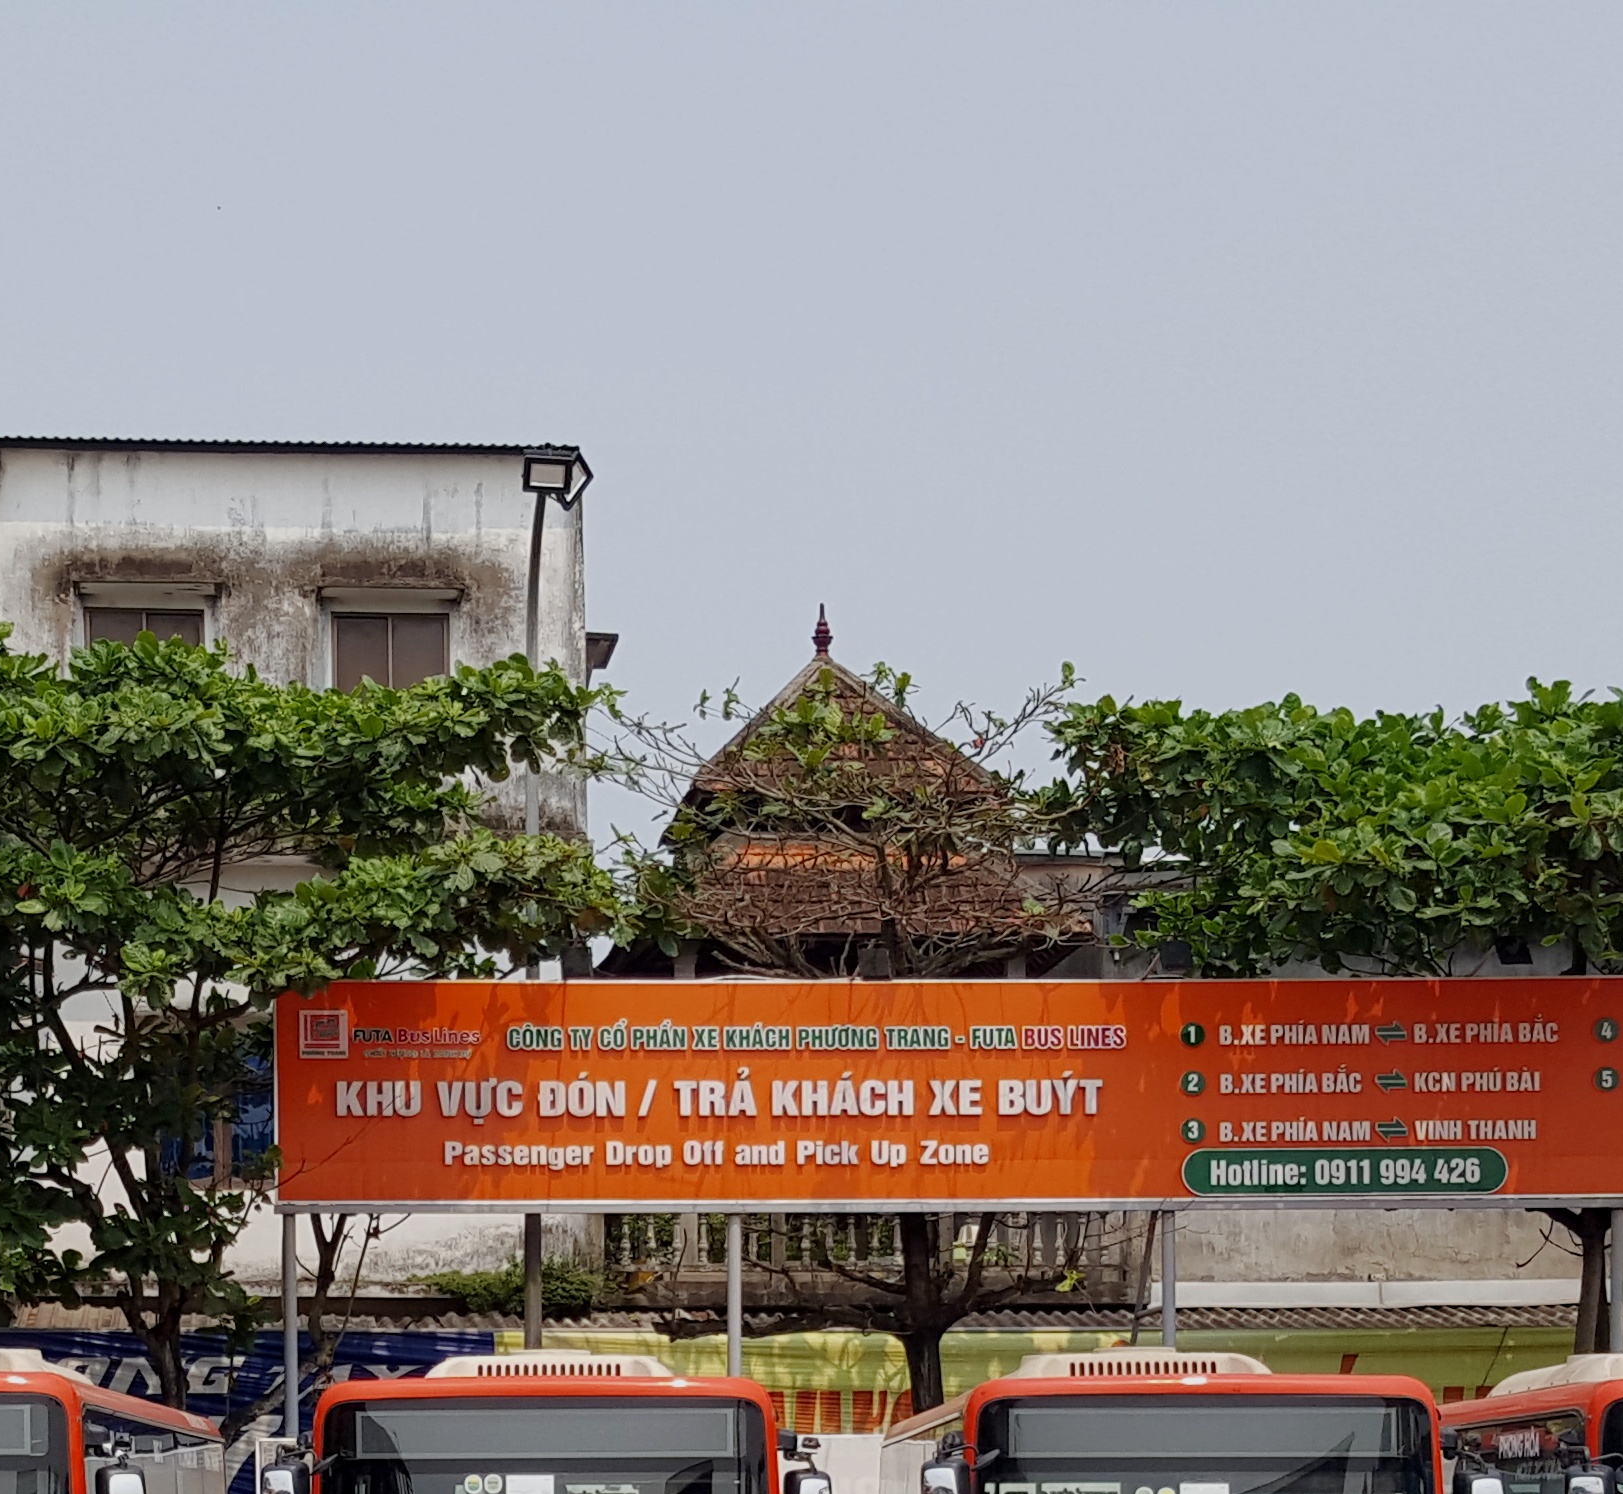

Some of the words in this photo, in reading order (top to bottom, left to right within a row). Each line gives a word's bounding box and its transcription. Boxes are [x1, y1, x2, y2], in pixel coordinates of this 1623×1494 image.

[352, 1028, 393, 1045] FUTA
[507, 1022, 564, 1050] CÔNG
[570, 1027, 592, 1050] TY
[598, 1018, 626, 1051] CỔ
[631, 1019, 686, 1051] PHẦN
[692, 1026, 721, 1050] XE
[723, 1022, 792, 1050] KHÁCH
[796, 1023, 879, 1050] PHƯƠNG
[884, 1026, 950, 1050] TRANG
[969, 1025, 1018, 1050] FUTA
[1022, 1025, 1064, 1049] BUS
[1067, 1025, 1127, 1049] LINES
[1218, 1024, 1267, 1046] B.XE
[1270, 1019, 1319, 1045] PHÍA
[1320, 1024, 1371, 1045] NAM
[1412, 1023, 1461, 1044] B.XE
[1464, 1016, 1514, 1044] PHÍA
[1517, 1013, 1560, 1043] BẮC
[1218, 1073, 1267, 1095] B.XE
[1270, 1067, 1319, 1094] PHÍA
[1320, 1064, 1363, 1093] BẮC
[1413, 1071, 1457, 1093] KCN
[1460, 1066, 1502, 1092] PHÚ
[1504, 1066, 1541, 1092] BÀI
[335, 1081, 423, 1117] KHU
[437, 1077, 524, 1125] VỰC
[538, 1071, 626, 1118] ĐÓN
[637, 1080, 657, 1118] /
[674, 1066, 757, 1118] TRẢ
[771, 1071, 915, 1117] KHÁCH
[928, 1079, 983, 1116] XE
[997, 1069, 1104, 1116] BUÝT
[1218, 1121, 1267, 1143] B.XE
[1270, 1116, 1319, 1142] PHÍA
[1321, 1121, 1371, 1142] NAM
[1413, 1119, 1463, 1141] VINH
[1467, 1118, 1537, 1141] THANH
[444, 1141, 594, 1170] Passenger
[605, 1140, 672, 1168] Drop
[682, 1141, 724, 1165] Off
[735, 1141, 785, 1166] and
[796, 1140, 859, 1166] Pick
[870, 1141, 907, 1168] Up
[919, 1141, 989, 1166] Zone
[1209, 1158, 1308, 1187] Hotline:
[1314, 1158, 1371, 1186] 0911
[1379, 1157, 1427, 1185] 994
[1433, 1157, 1481, 1185] 426
